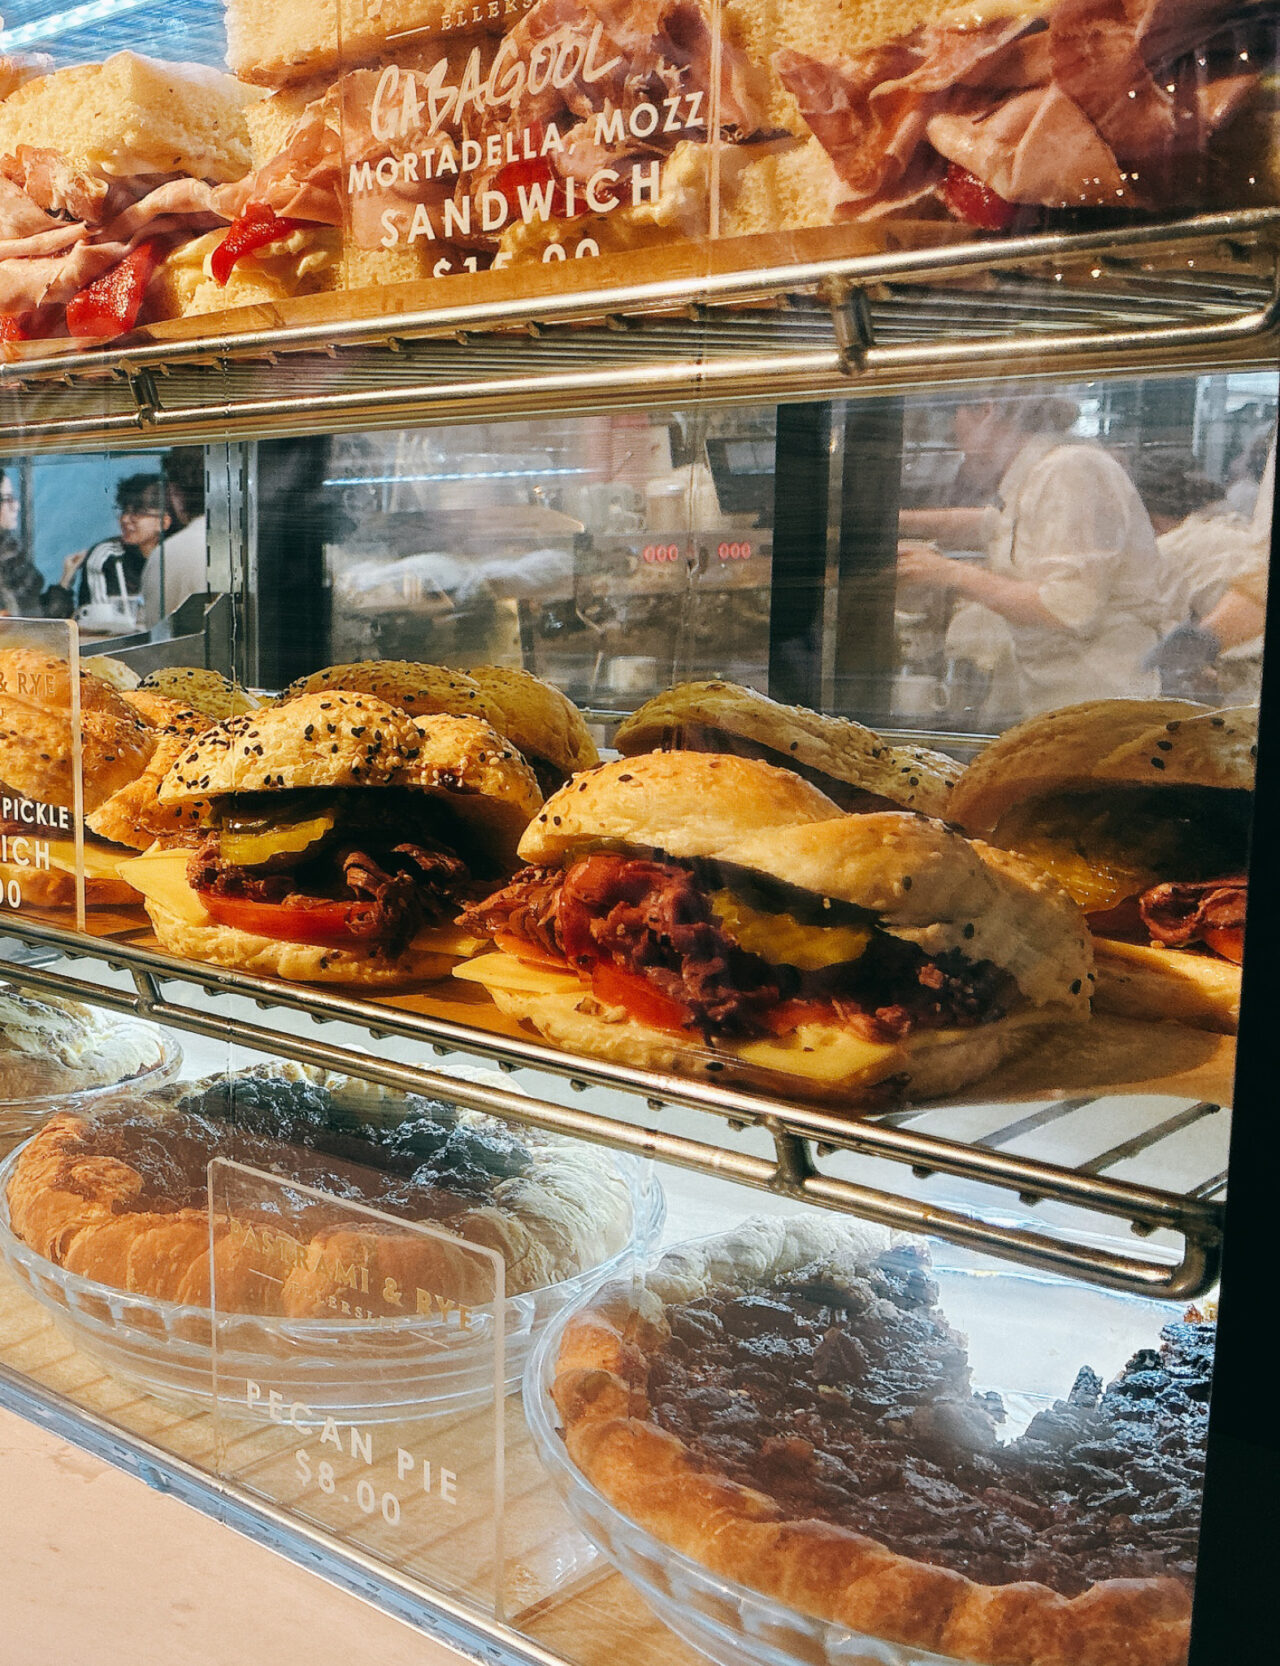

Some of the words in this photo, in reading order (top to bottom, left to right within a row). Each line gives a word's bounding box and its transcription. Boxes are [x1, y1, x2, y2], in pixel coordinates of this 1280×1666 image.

[347, 127, 576, 194] MORTADELLA,
[593, 91, 705, 146] MOZZ
[380, 159, 662, 248] SANDWICH
[17, 672, 57, 697] RYE
[2, 796, 70, 830] PICKLE
[383, 1277, 403, 1308] &
[416, 1287, 473, 1332] RYE
[245, 1377, 373, 1465] PECAN
[396, 1446, 458, 1506] PIE
[294, 1448, 402, 1526] $8.00
